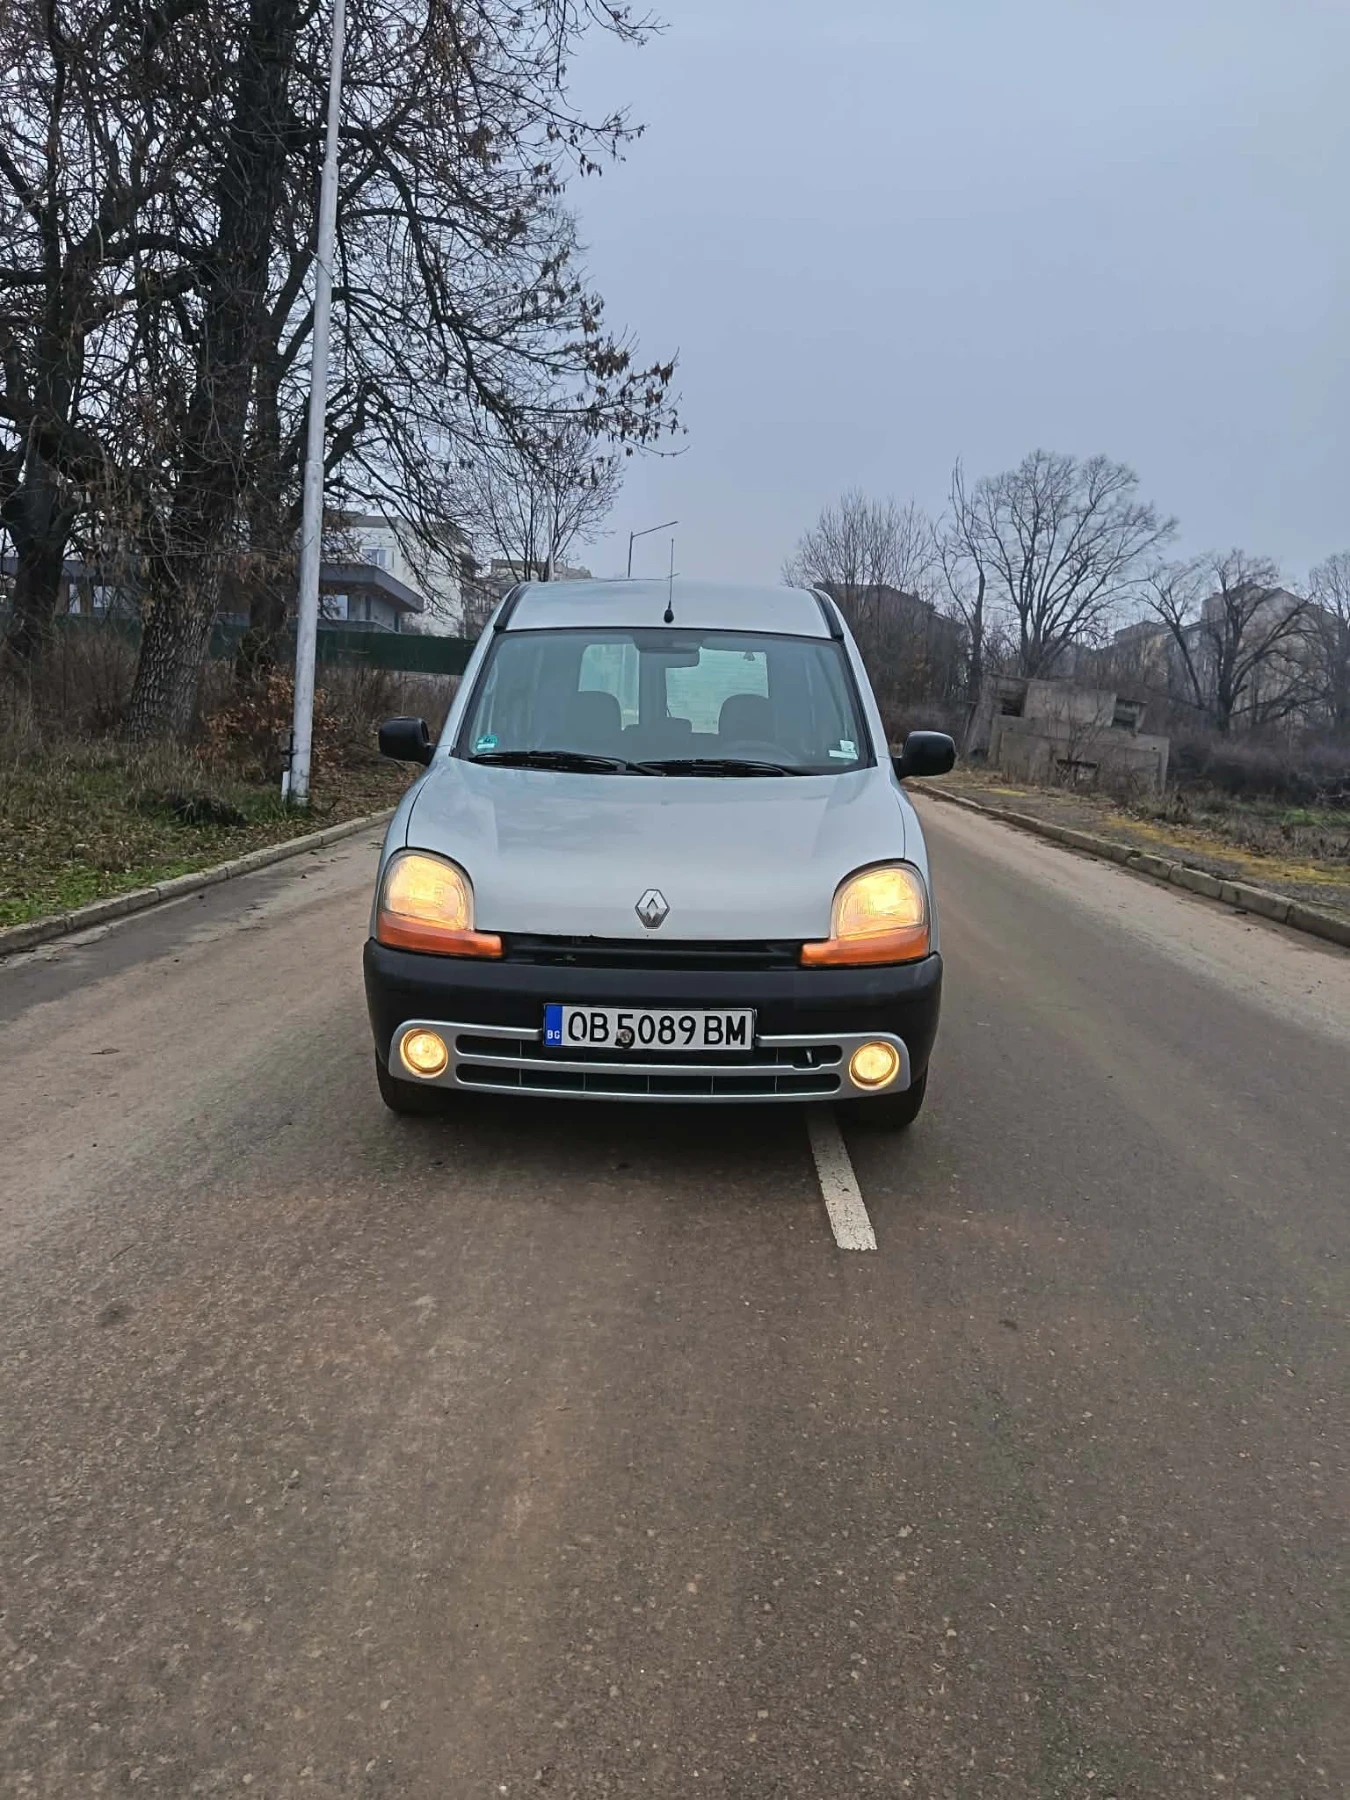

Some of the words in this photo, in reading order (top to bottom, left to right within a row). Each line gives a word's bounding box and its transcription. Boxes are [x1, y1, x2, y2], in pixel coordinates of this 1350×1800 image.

[546, 1030, 561, 1040] BG
[615, 1013, 697, 1048] 5089
[703, 1015, 746, 1045] BM
